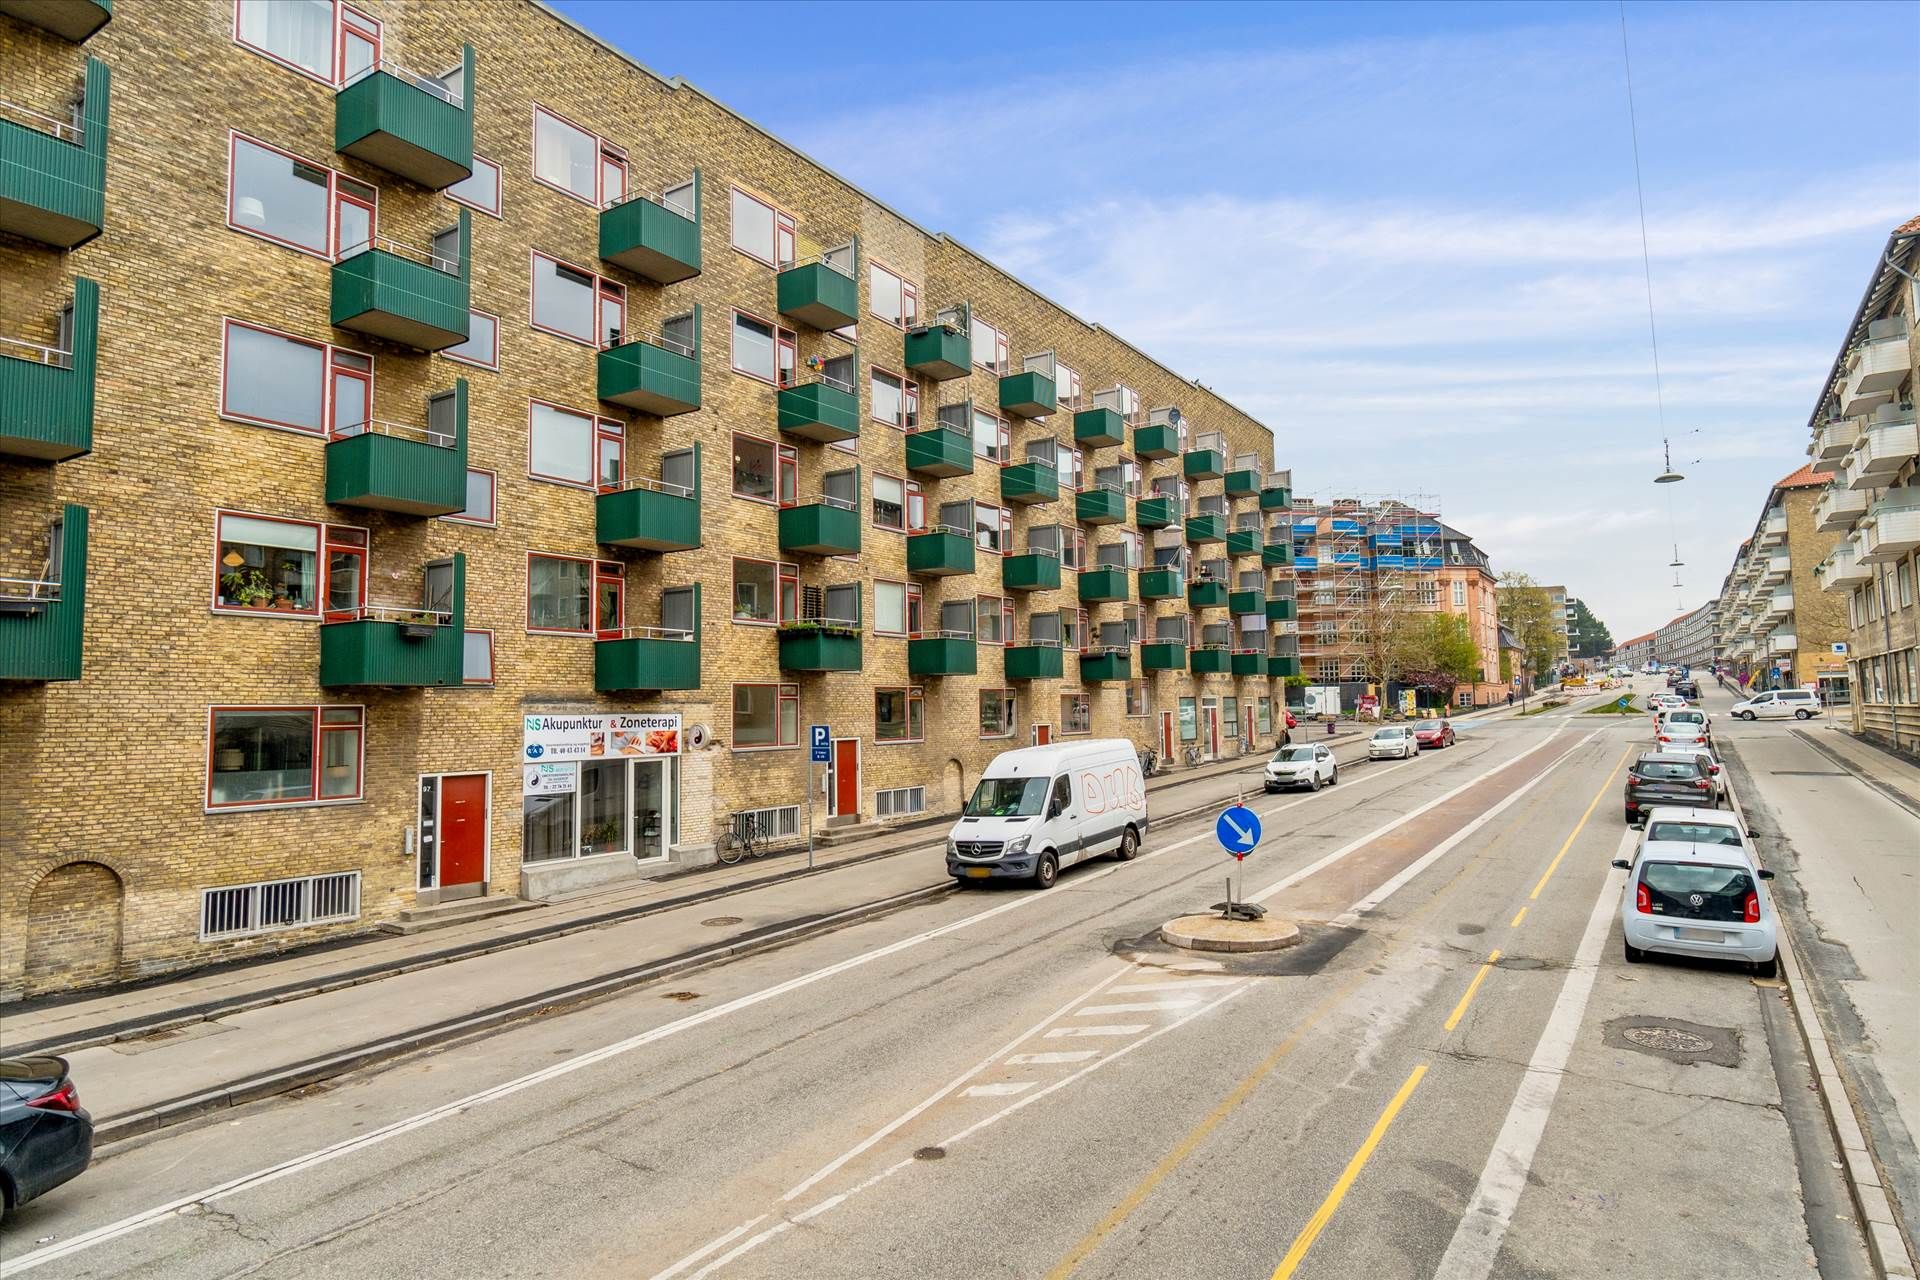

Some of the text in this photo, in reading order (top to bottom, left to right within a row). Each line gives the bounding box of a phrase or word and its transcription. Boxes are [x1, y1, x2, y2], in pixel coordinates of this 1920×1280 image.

[542, 717, 603, 733] Akupunktur
[610, 719, 617, 728] &
[620, 716, 678, 730] Zoneterapi
[815, 728, 826, 746] P
